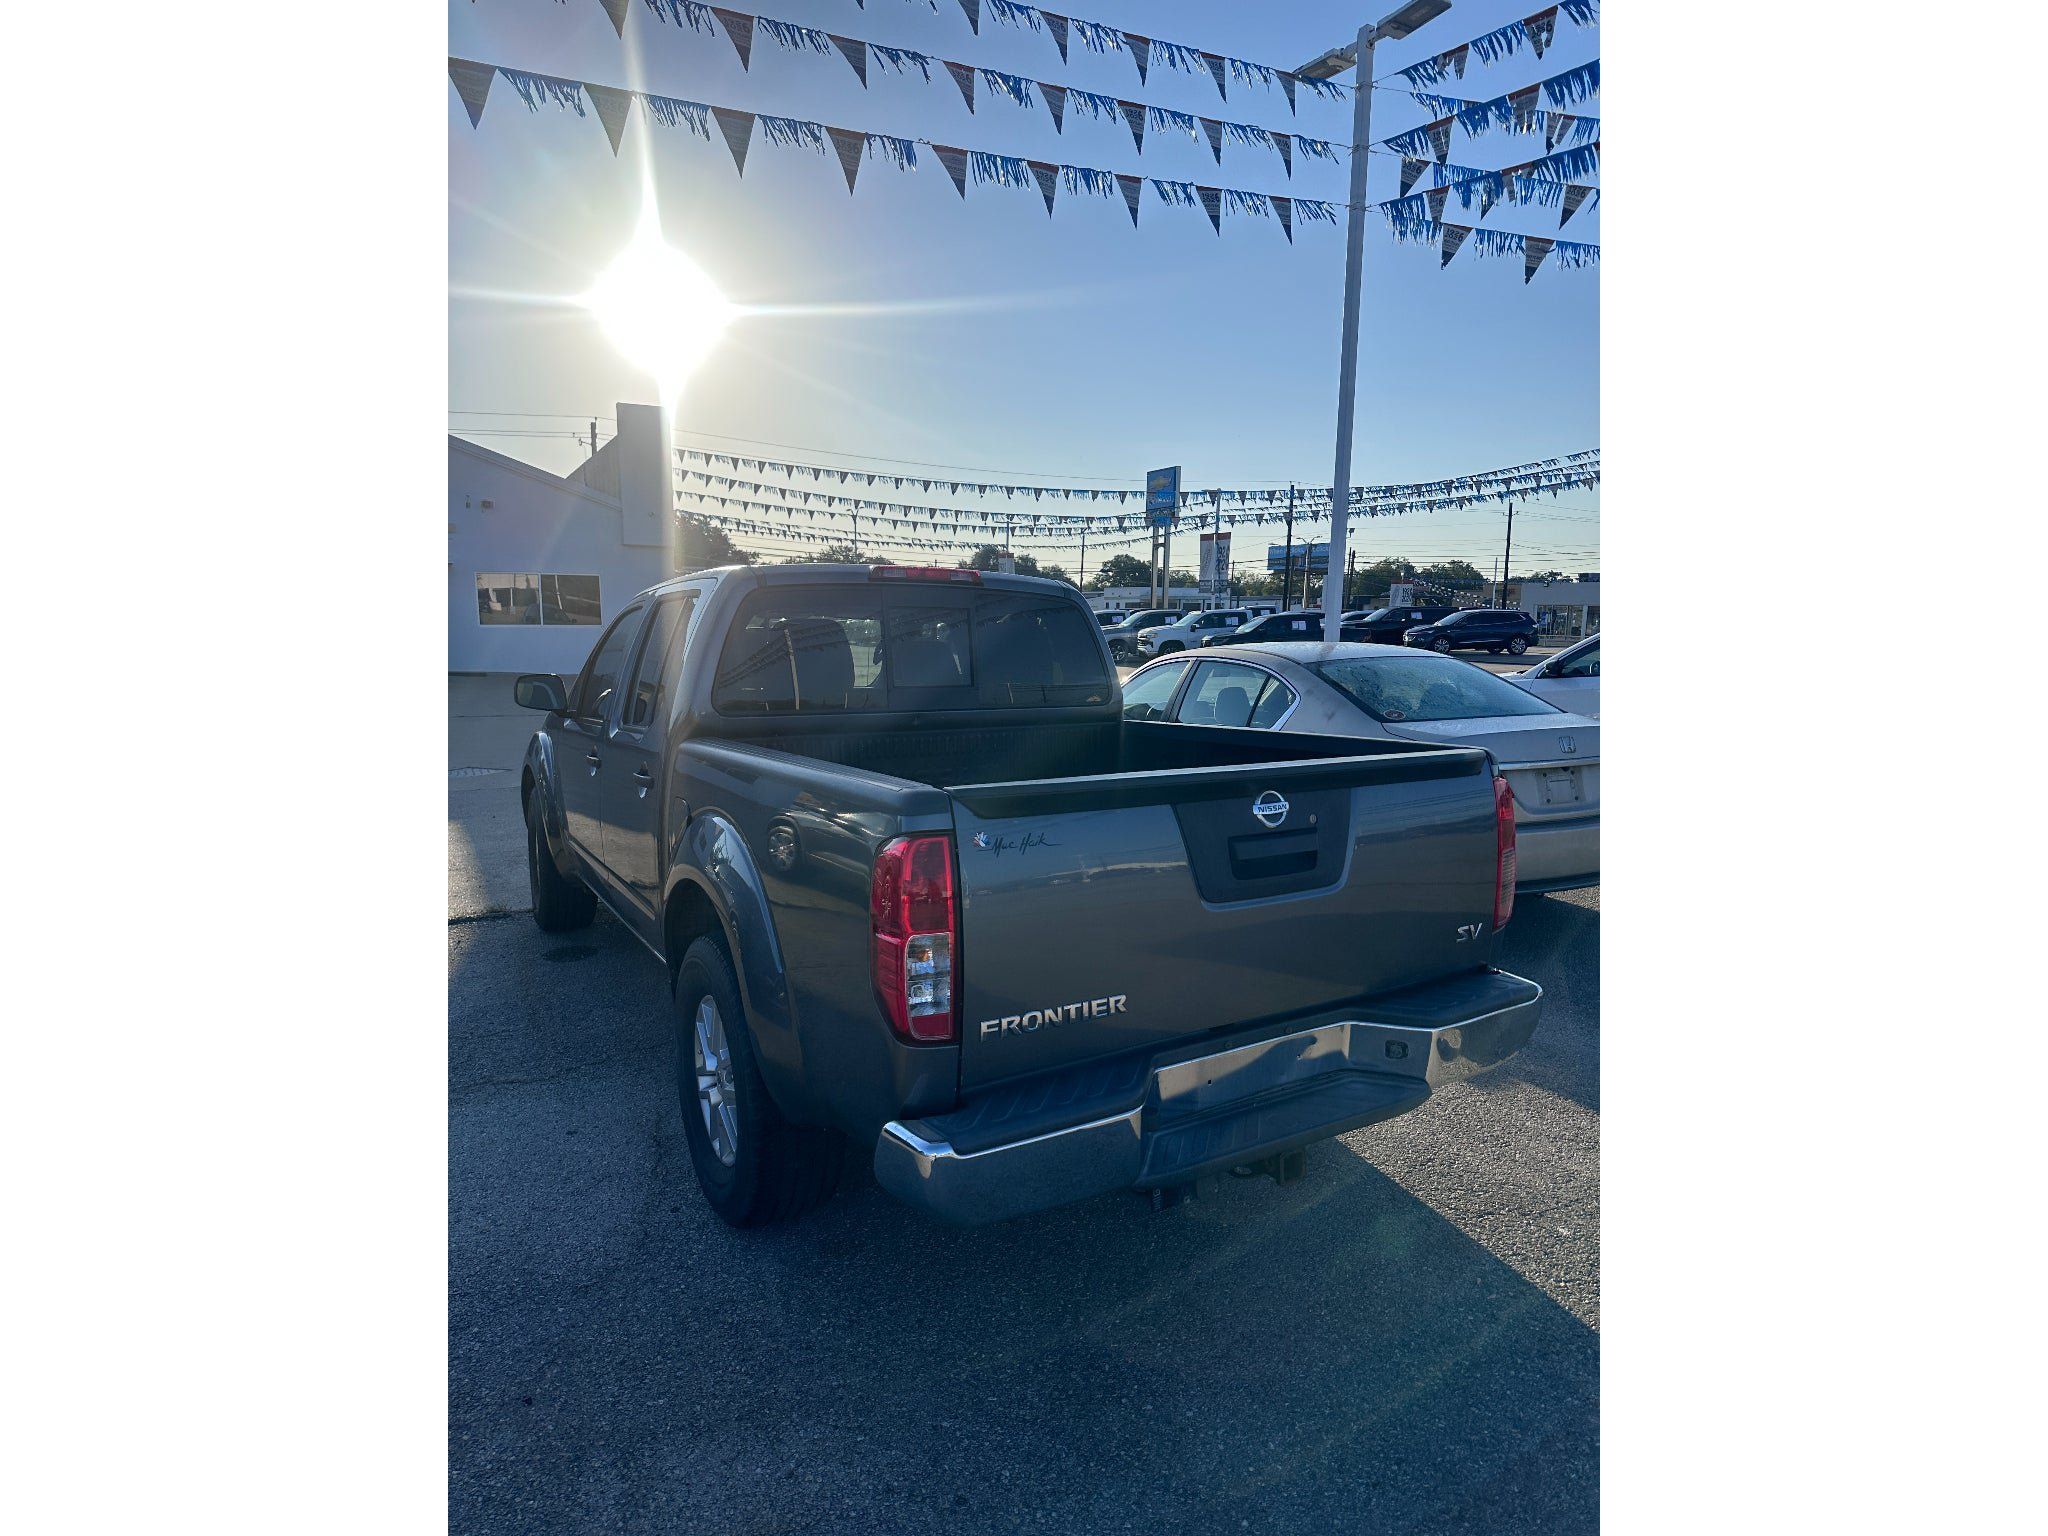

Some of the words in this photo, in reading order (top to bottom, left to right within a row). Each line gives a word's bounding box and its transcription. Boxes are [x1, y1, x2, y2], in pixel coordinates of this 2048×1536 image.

[1257, 803, 1287, 813] NISSAN
[1456, 922, 1483, 943] SV
[980, 994, 1128, 1042] FRONTIER
